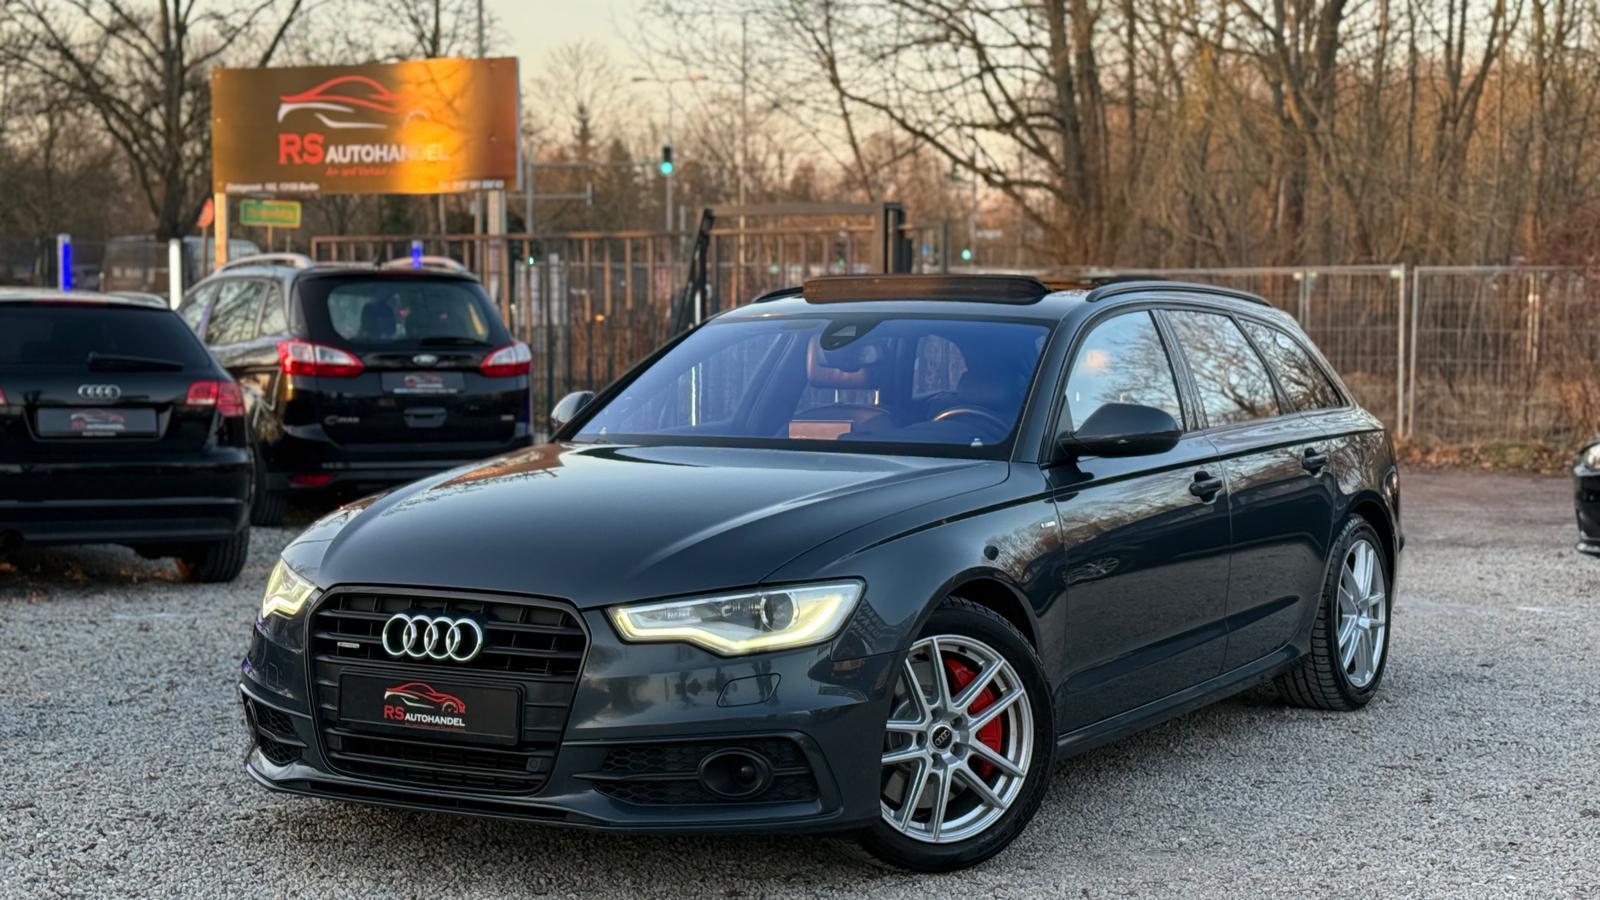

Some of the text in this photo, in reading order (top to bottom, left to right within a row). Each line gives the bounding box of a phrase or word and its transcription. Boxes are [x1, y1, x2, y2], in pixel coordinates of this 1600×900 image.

[278, 133, 448, 165] RS AUTOHANDEL
[383, 704, 466, 727] RS AUTOHANDEL
